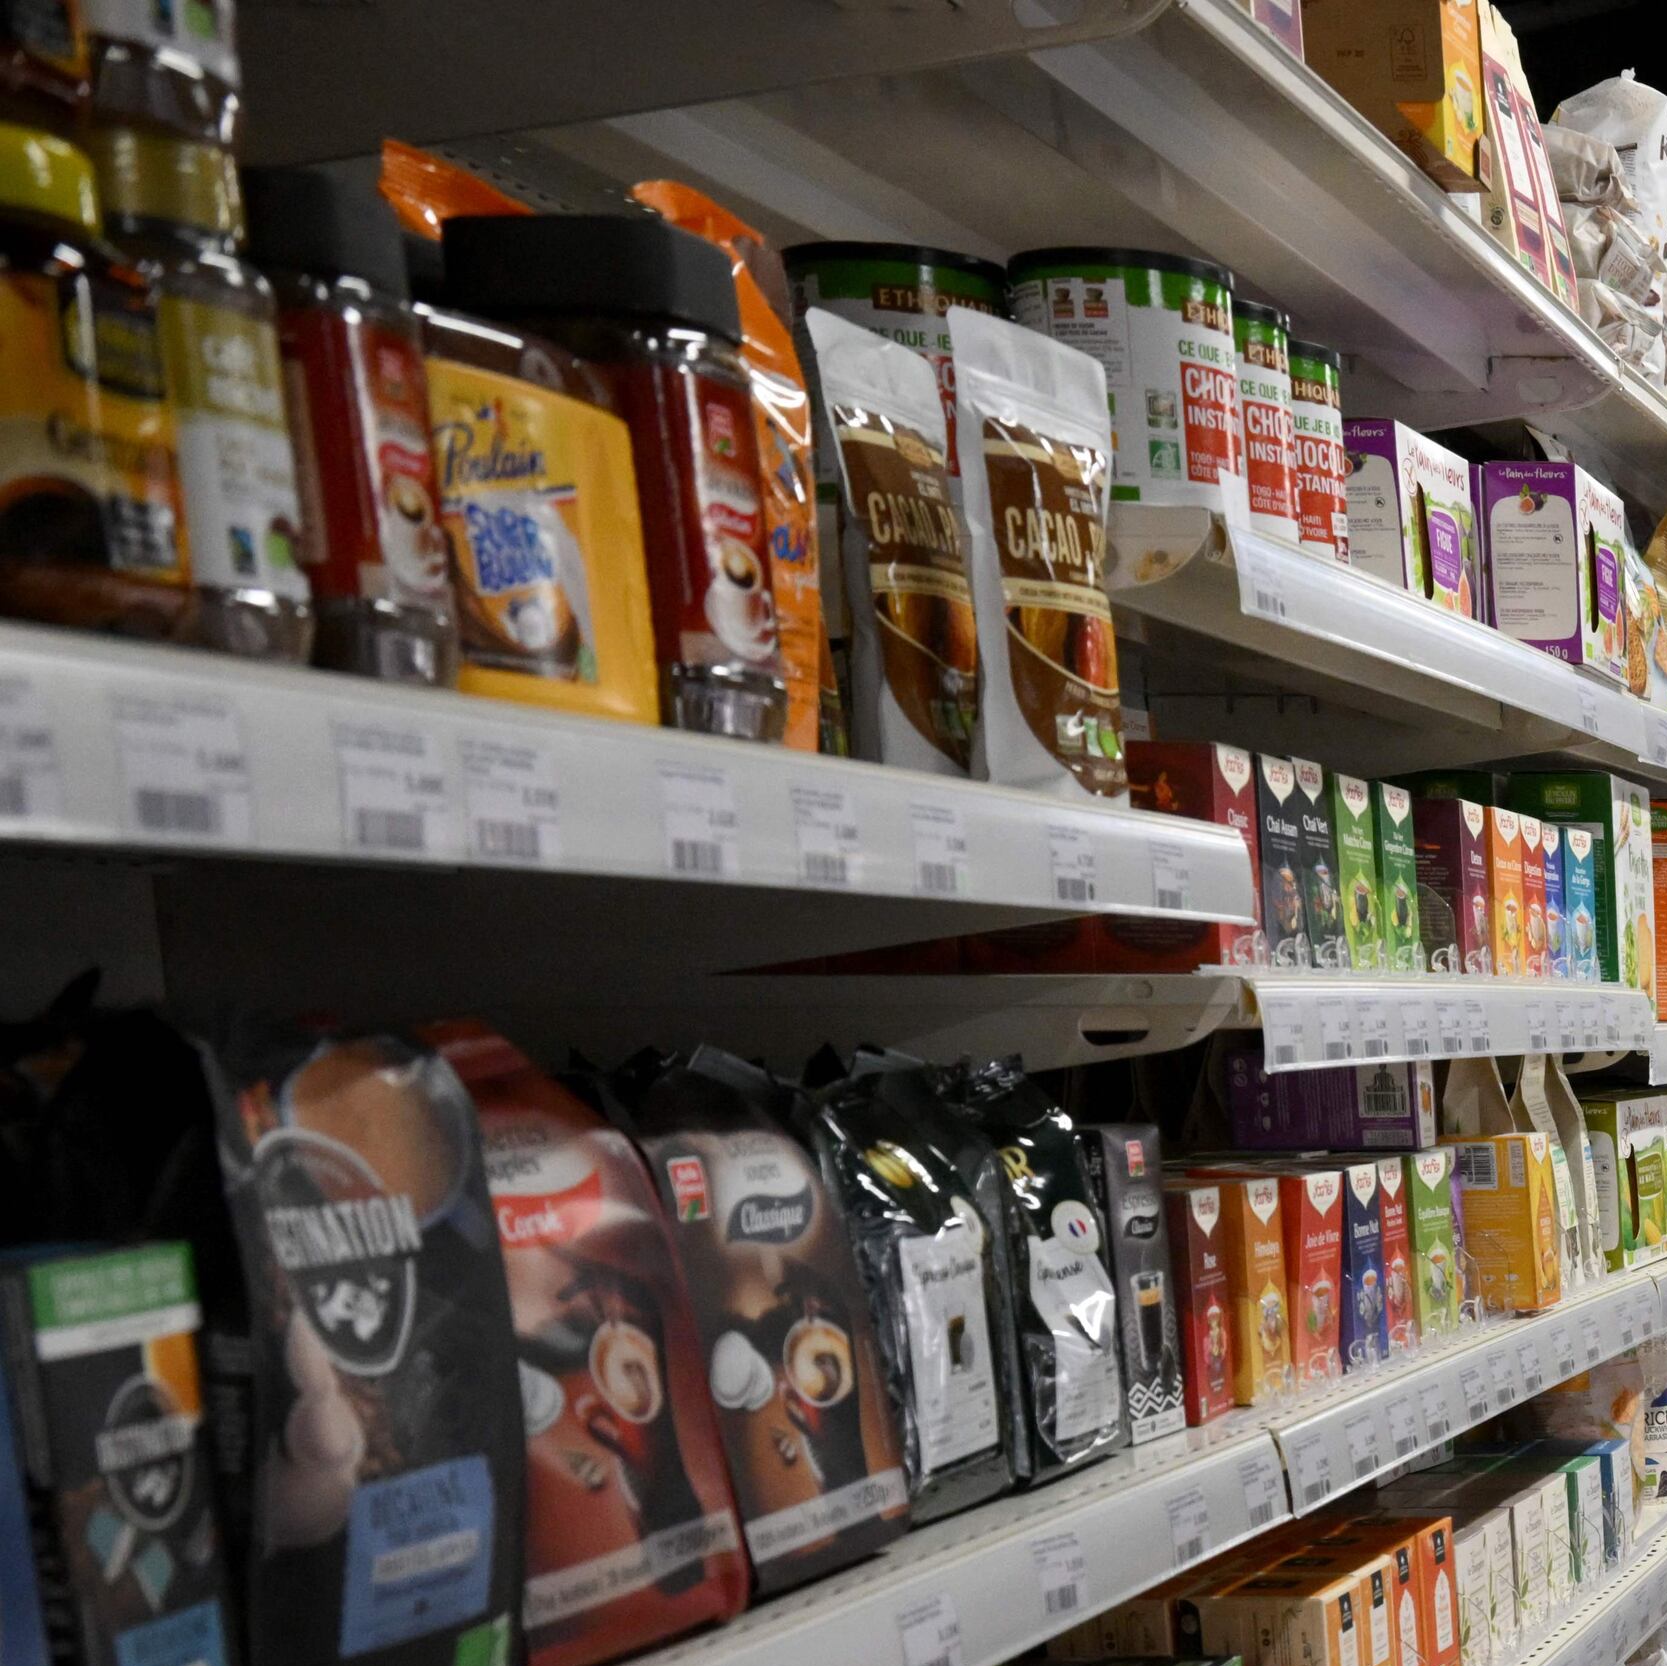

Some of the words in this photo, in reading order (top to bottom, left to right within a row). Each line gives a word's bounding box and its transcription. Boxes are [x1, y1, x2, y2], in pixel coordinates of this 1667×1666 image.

[1294, 418, 1309, 432] UE
[1352, 427, 1385, 438] fleurs
[1505, 467, 1524, 479] Pain
[1534, 468, 1566, 479] fleurs
[1005, 507, 1082, 567] CACAO
[1227, 808, 1249, 829] Classic
[1266, 814, 1281, 832] Chai
[1281, 817, 1298, 838] Assam
[1302, 814, 1316, 831] Chai
[1315, 815, 1329, 835] Vert
[740, 1203, 805, 1238] Classique
[1353, 1221, 1367, 1239] Bonne
[1304, 1232, 1318, 1249] Joie
